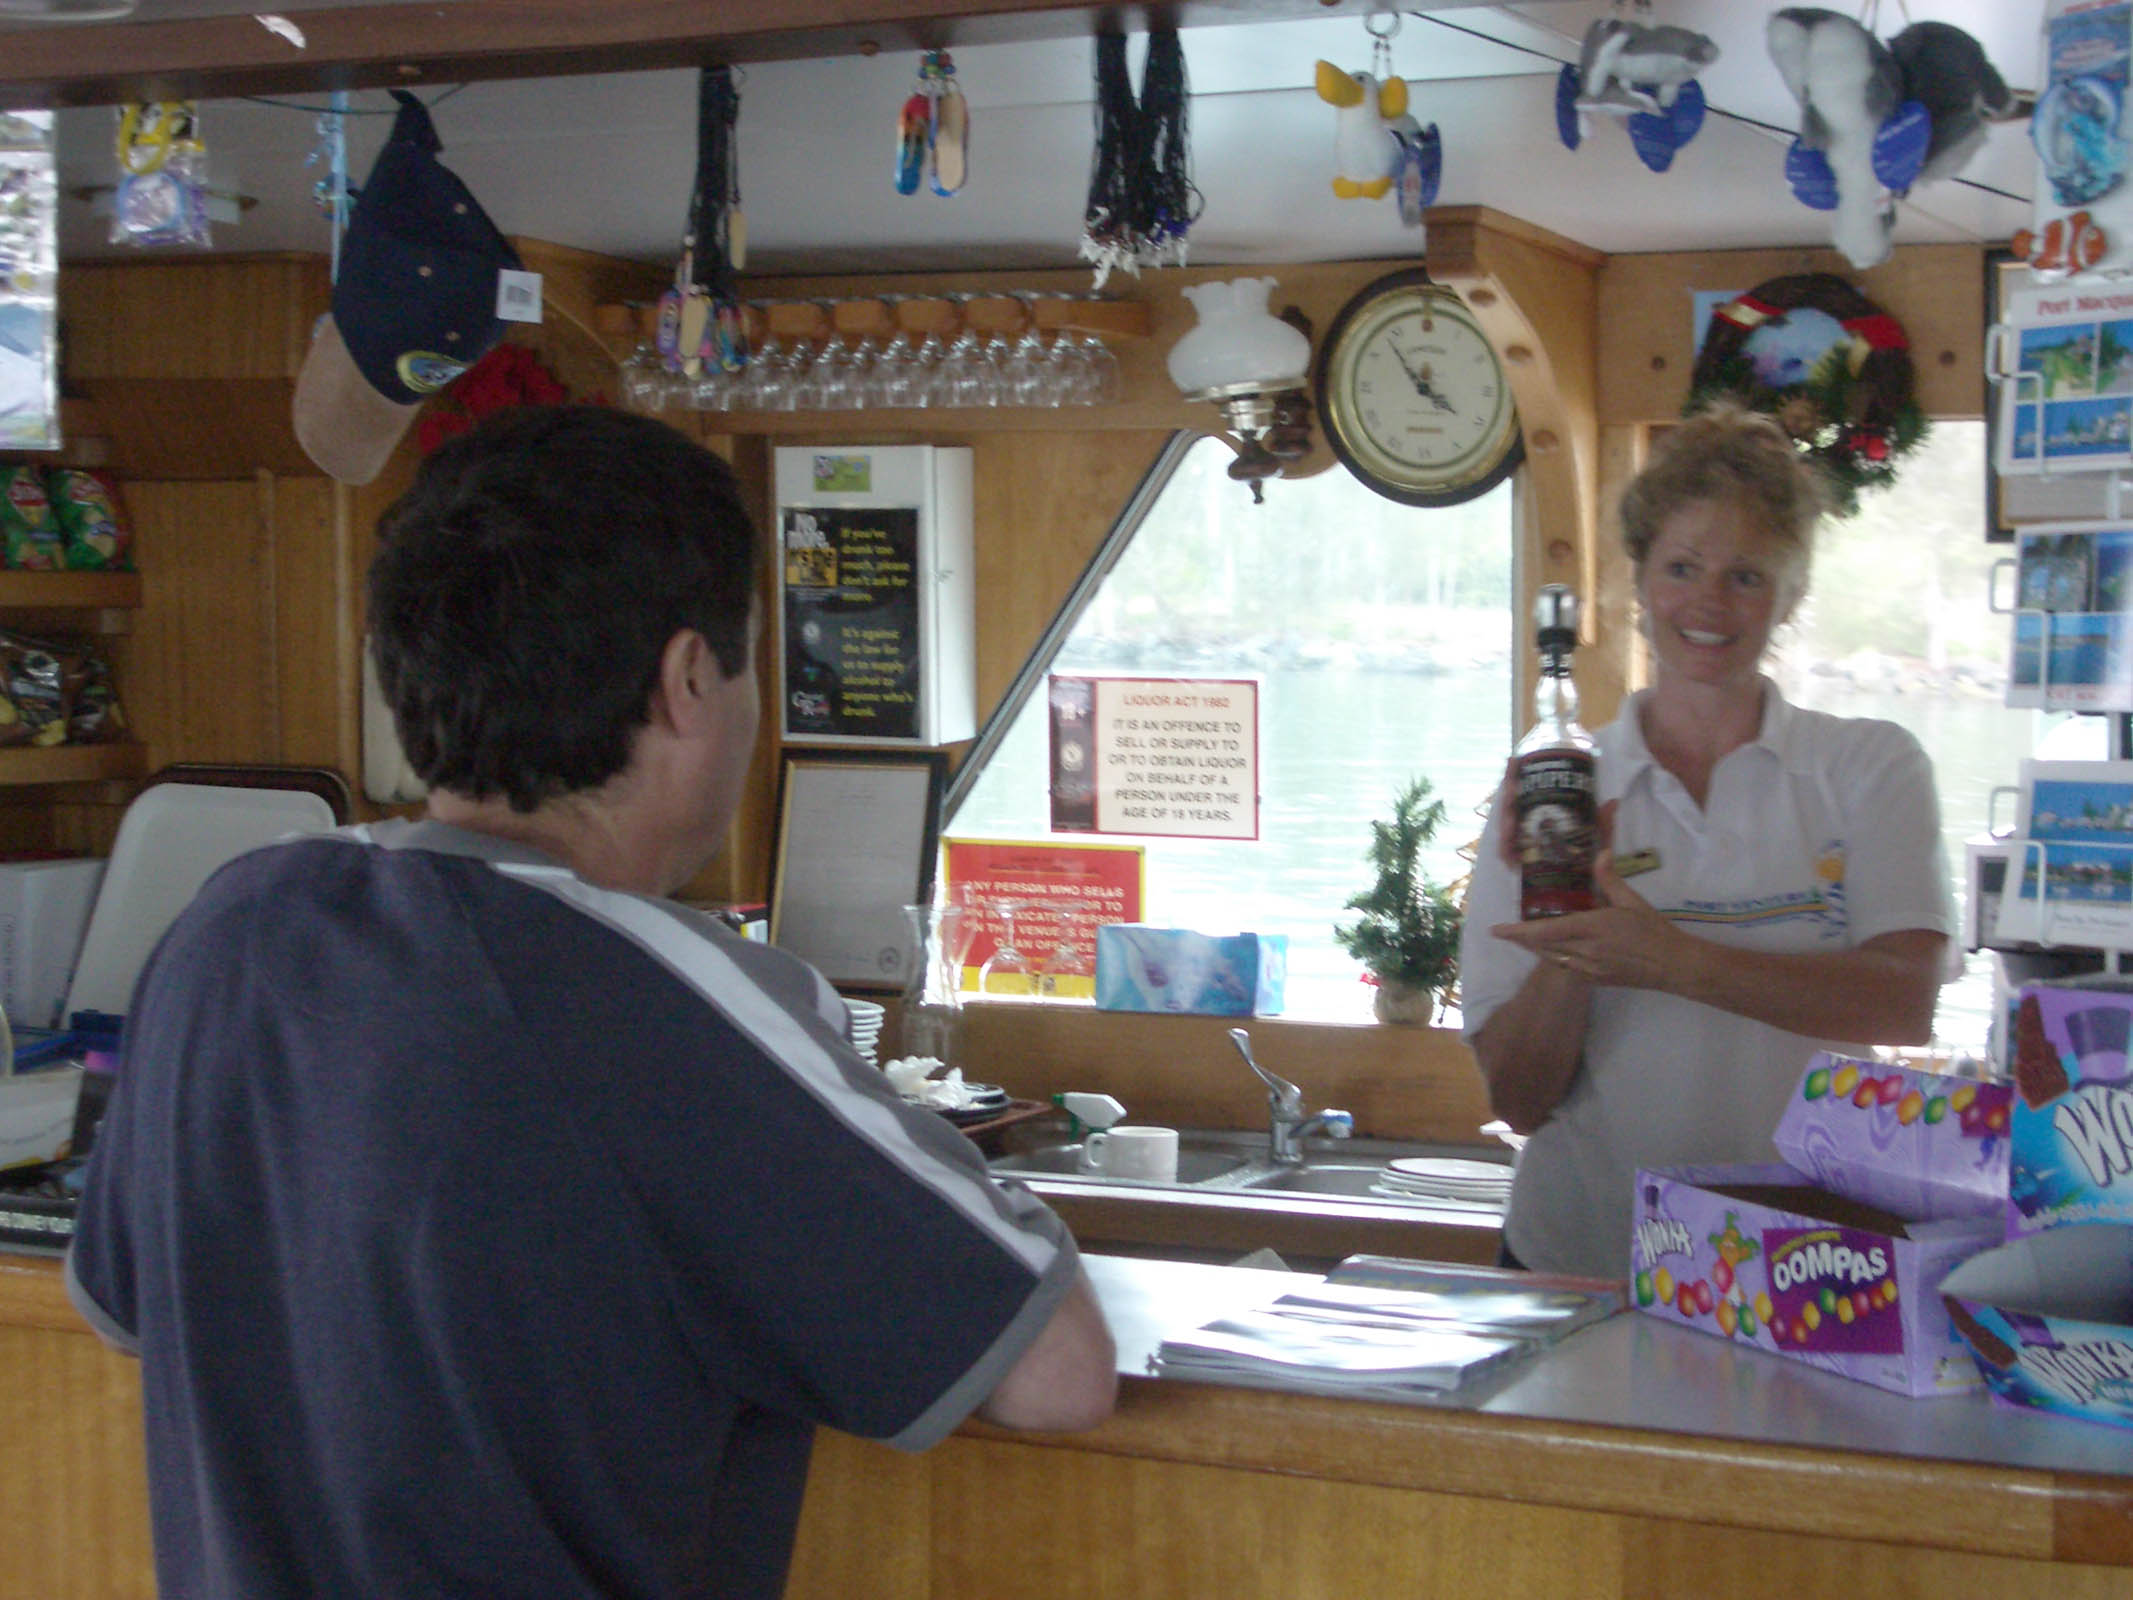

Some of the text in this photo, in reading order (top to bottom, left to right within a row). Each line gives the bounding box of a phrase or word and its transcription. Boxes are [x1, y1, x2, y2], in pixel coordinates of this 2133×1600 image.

[1123, 695, 1170, 707] LIQUOR
[1175, 695, 1198, 707] ACT
[1113, 719, 1241, 733] IT IS AN OFFENCE TO
[1115, 737, 1239, 750] SELL OR SUPPLY TO
[1109, 754, 1247, 769] OR TO OBTAIN LIQUOR
[1126, 771, 1229, 785] ON BEHALF OF A
[1116, 789, 1240, 805] PERSON UNDER THE
[1122, 807, 1147, 818] AGE
[1151, 807, 1168, 819] OF
[993, 881, 1047, 894] PERSON
[1049, 884, 1081, 896] WHO
[1083, 886, 1124, 898] SELLS
[1105, 901, 1124, 912] TO
[1773, 1241, 1888, 1291] OOMPAS
